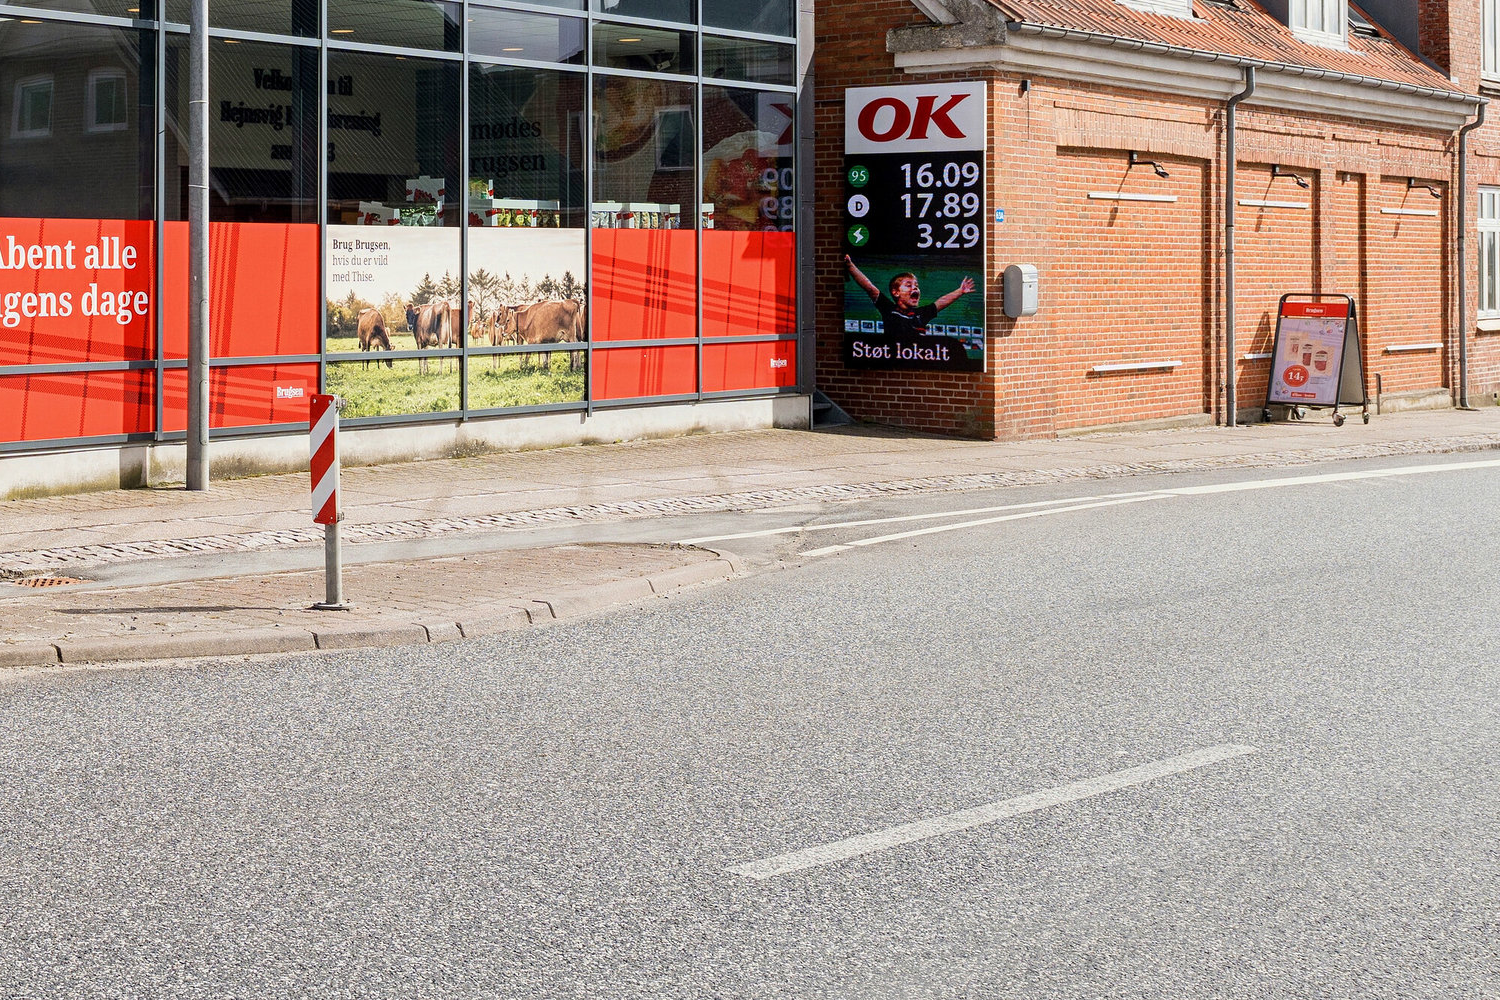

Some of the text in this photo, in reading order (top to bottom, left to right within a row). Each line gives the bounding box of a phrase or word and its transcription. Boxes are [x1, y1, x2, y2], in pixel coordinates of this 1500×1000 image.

[857, 93, 971, 142] OK
[851, 161, 980, 188] 95 16.09
[855, 201, 863, 211] D
[900, 192, 980, 218] 17.89
[332, 239, 391, 252] Brug Brugsen,
[916, 223, 980, 248] 3.29
[84, 236, 137, 270] alle
[332, 254, 388, 266] hvis du er vild
[332, 271, 375, 282] med Thise.
[81, 283, 149, 325] dage
[852, 341, 950, 361] Støt lokalt
[276, 386, 303, 399] Brugsen
